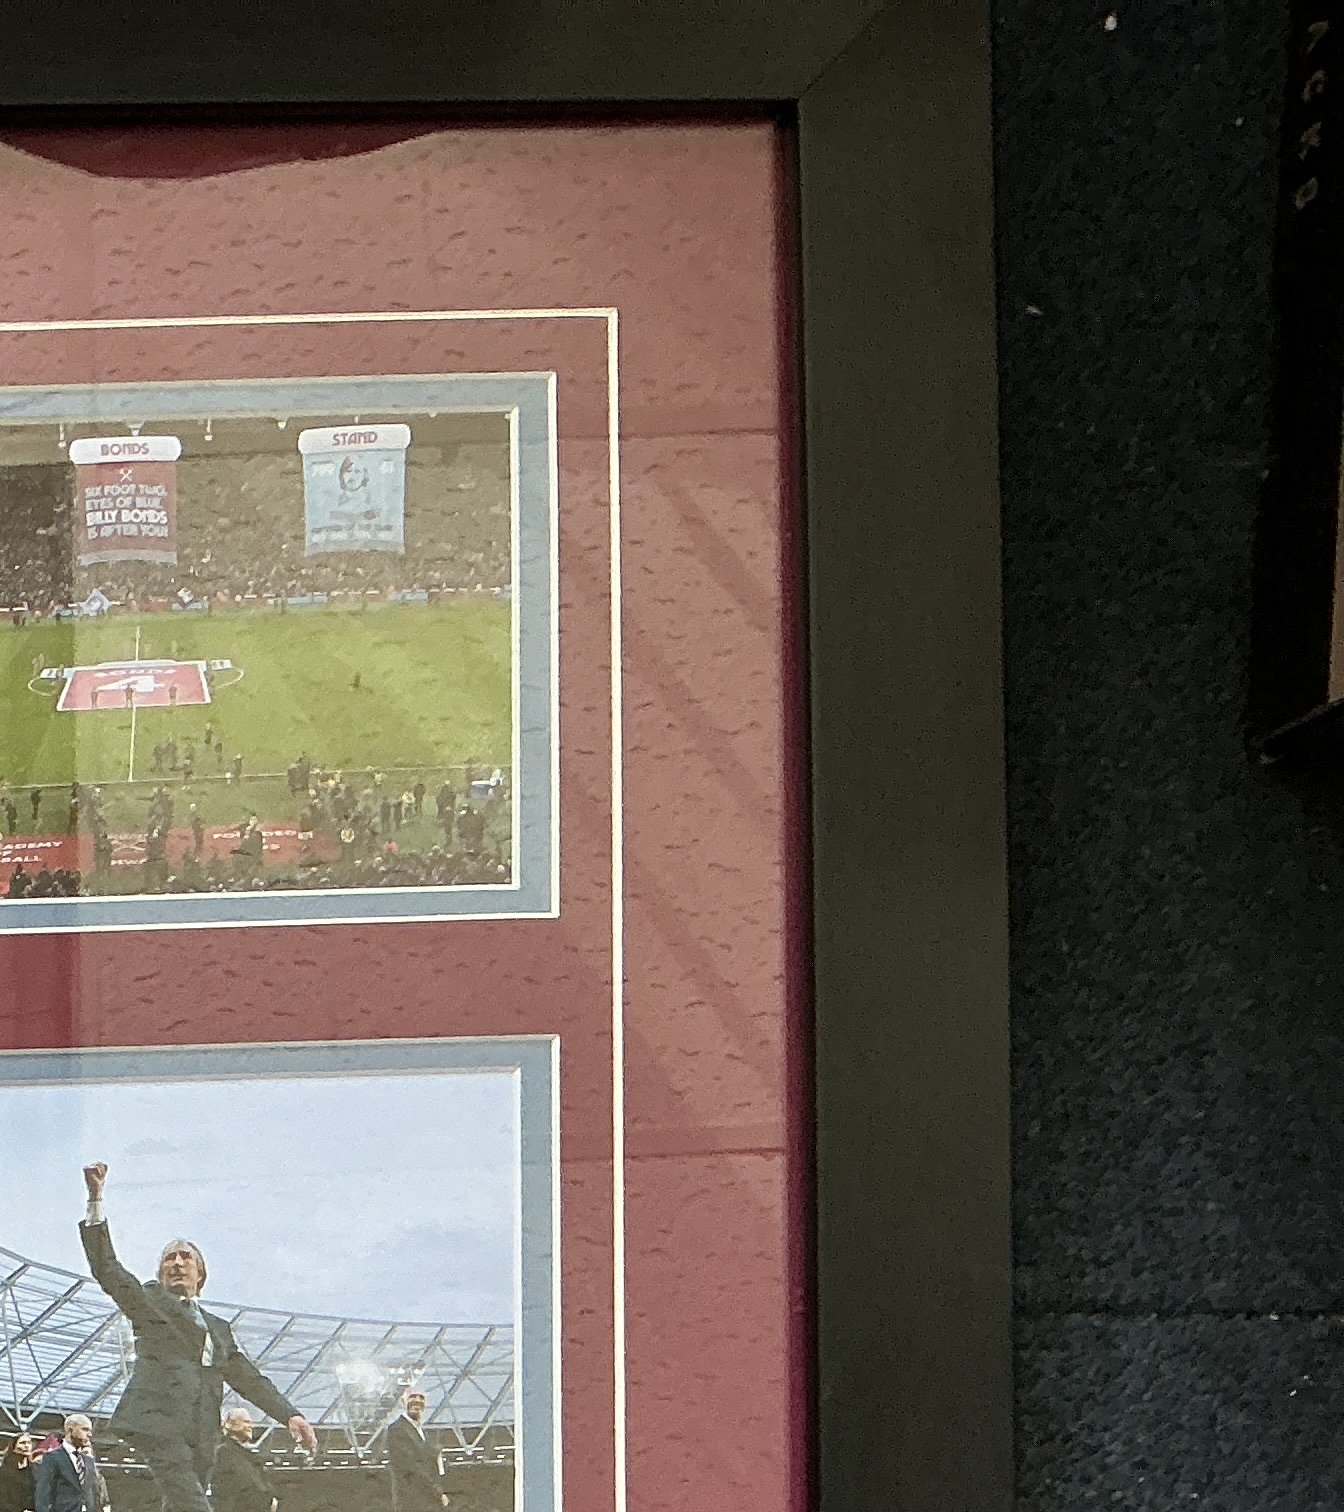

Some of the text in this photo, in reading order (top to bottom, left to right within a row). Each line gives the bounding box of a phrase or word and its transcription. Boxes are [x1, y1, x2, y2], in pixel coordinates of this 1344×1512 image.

[332, 431, 379, 446] STAND
[100, 442, 150, 456] BONDS
[85, 508, 169, 526] BILLY BONDS
